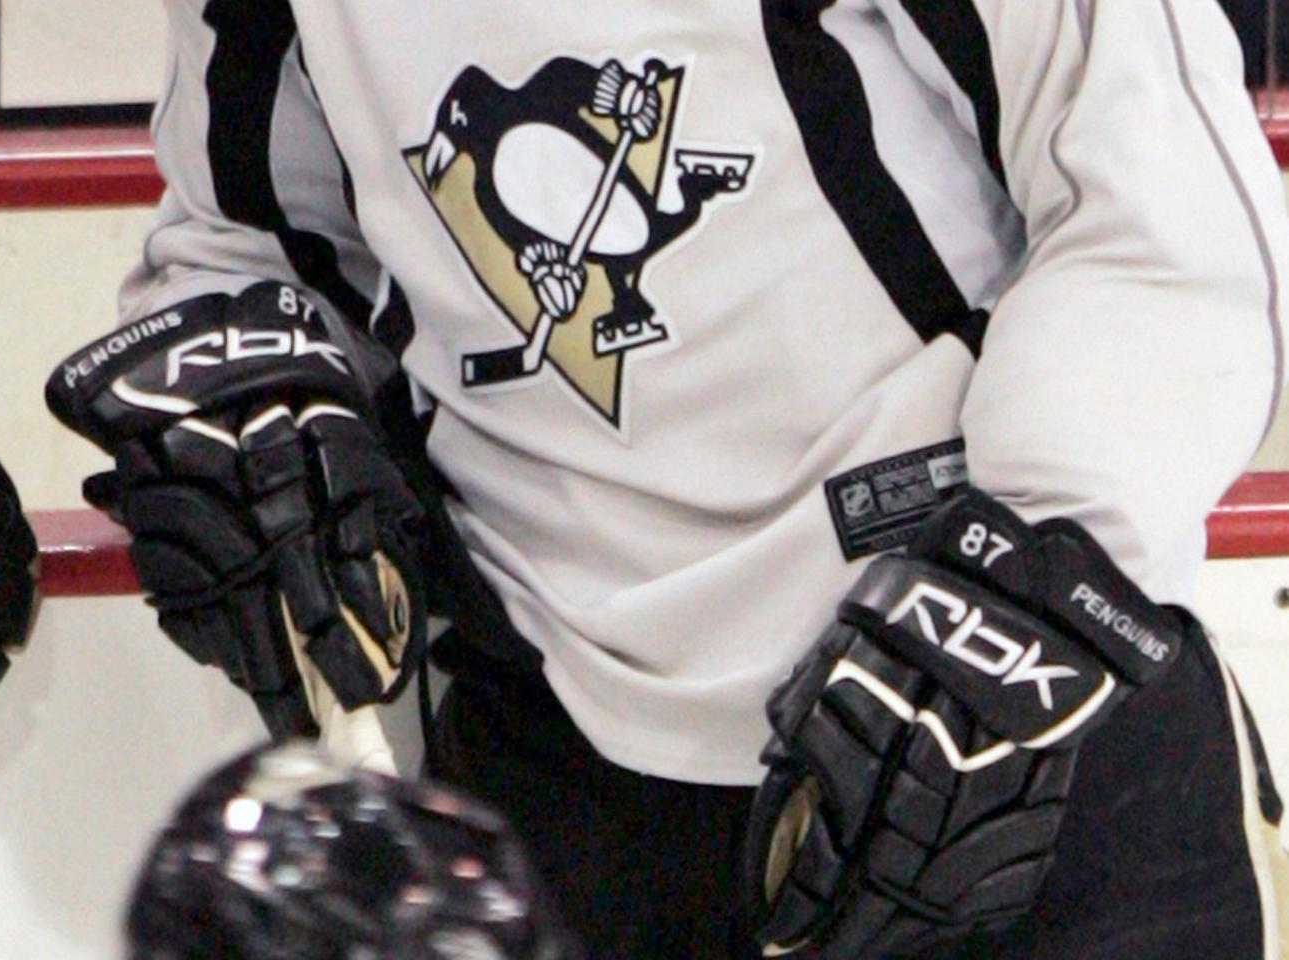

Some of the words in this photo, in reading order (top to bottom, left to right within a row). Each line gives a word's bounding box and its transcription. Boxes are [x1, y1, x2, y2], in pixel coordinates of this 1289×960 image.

[278, 285, 315, 323] 87
[63, 310, 184, 390] PENGUINS
[959, 522, 1014, 568] 87
[1069, 581, 1171, 664] PENGUINS
